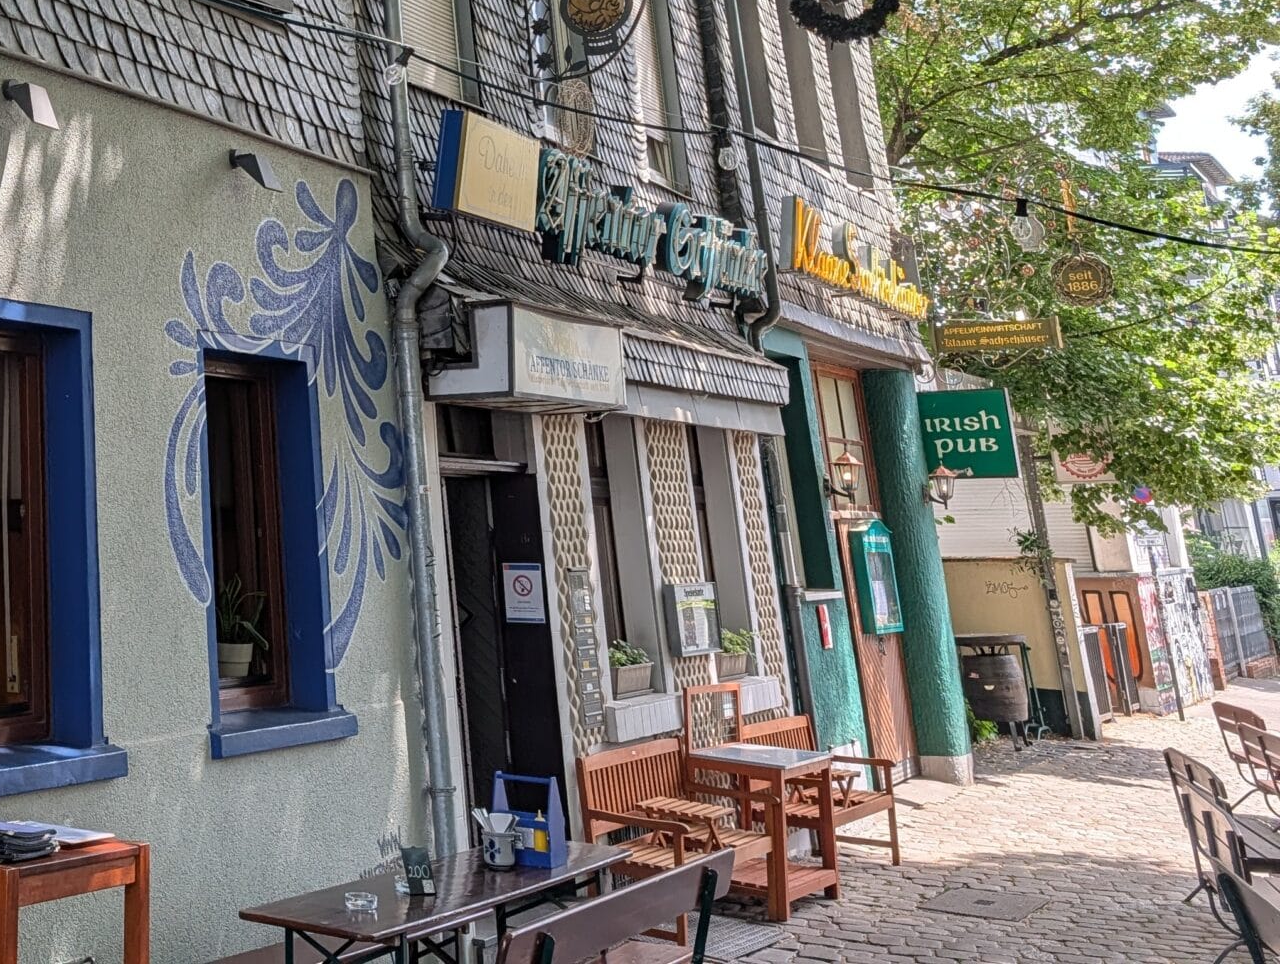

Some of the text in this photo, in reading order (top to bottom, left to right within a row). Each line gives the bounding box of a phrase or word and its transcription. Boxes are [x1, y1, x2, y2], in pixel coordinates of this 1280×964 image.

[1068, 270, 1093, 281] seit
[1068, 280, 1099, 292] 1886
[943, 322, 1043, 335] APFELWEINWIRTSCHAFT
[408, 864, 430, 879] 200
